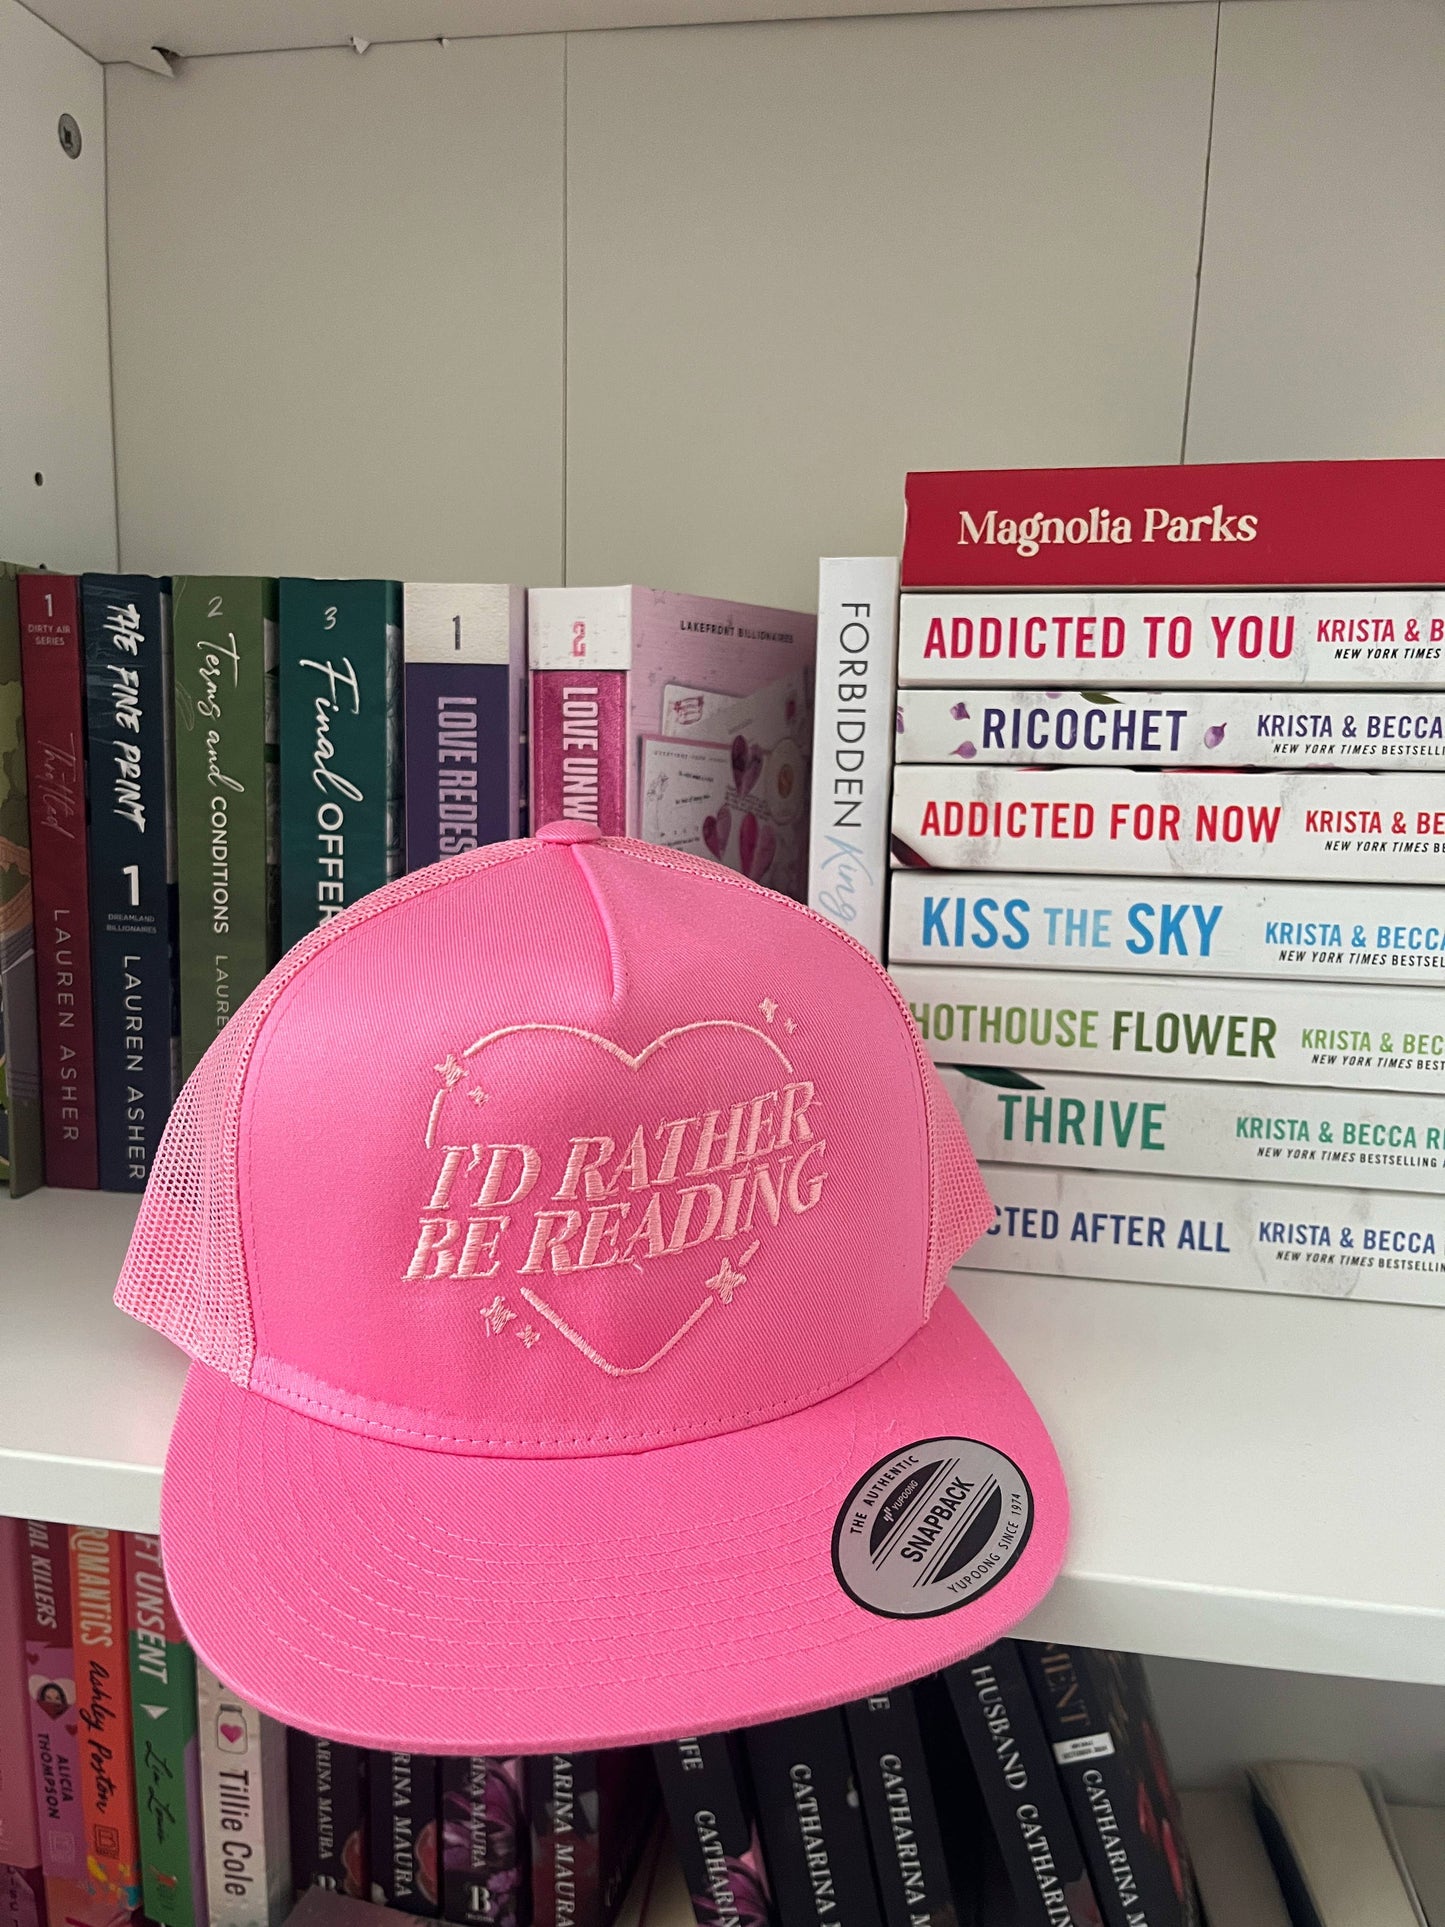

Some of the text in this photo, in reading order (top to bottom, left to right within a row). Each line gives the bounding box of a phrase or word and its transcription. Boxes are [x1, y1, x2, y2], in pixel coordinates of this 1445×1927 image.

[957, 504, 1259, 557] Magnolia Parks
[28, 625, 71, 634] DIRTY AIR
[45, 594, 53, 617] 1
[207, 595, 223, 618] 2
[323, 606, 338, 631] 3
[680, 620, 734, 636] LAKEFRONT
[1317, 619, 1395, 642] KRISTA
[1404, 618, 1420, 642] &
[35, 636, 65, 646] SERIES
[452, 615, 461, 650] 1
[572, 621, 586, 658] 2
[923, 615, 1296, 659] ADDICTED TO YOU
[1334, 648, 1441, 659] NEW YORK TIMES
[103, 603, 146, 833] THE FINE PRINT
[299, 656, 364, 801] Final
[982, 708, 1188, 751] RICOCHET
[1257, 714, 1443, 738] KRISTA & BECCA
[562, 687, 599, 825] LOVE UNW
[818, 602, 874, 925] FORBIDDEN King
[1273, 744, 1299, 754] NEW
[1305, 744, 1336, 754] YORK
[1340, 744, 1377, 755] TIMES
[438, 696, 478, 860] LOVE REDES
[197, 633, 244, 1032] Terms and CONDITIONS LAURE
[920, 801, 1282, 843] ADDICTED FOR NOW
[1305, 810, 1382, 833] KRISTA
[1391, 811, 1406, 834] &
[1324, 841, 1351, 851] NEW
[1356, 841, 1388, 852] YORK
[1392, 842, 1429, 852] TIMES
[122, 864, 140, 906] 1
[106, 924, 157, 934] BILLIONAIRES
[108, 913, 155, 923] DREAMLAND
[922, 896, 1223, 957] KISS THE SKY
[1265, 922, 1342, 947] KRISTA
[1351, 925, 1367, 948] &
[1279, 950, 1306, 962] NEW
[1312, 951, 1344, 964] YORK
[1349, 953, 1387, 965] TIMES
[54, 909, 79, 1141] LAUREN ASHER
[909, 1002, 1278, 1058] HOTHOUSE FLOWER
[1301, 1028, 1371, 1052] KRISTA
[1379, 1032, 1393, 1053] &
[124, 956, 146, 1180] LAUREN ASHER
[1311, 1054, 1337, 1065] NEW
[1342, 1056, 1371, 1067] YORK
[1377, 1057, 1412, 1069] TIMES
[424, 1081, 823, 1210] I'D RATHER
[998, 1094, 1167, 1151] THRIVE
[1236, 1117, 1310, 1142] KRISTA
[1318, 1121, 1333, 1143] &
[1342, 1123, 1417, 1148] BECCA
[1257, 1147, 1282, 1158] NEW
[1286, 1149, 1316, 1160] YORK
[1320, 1150, 1356, 1163] TIMES
[1360, 1153, 1437, 1168] BESTSELLING
[401, 1139, 829, 1281] BE READING
[1070, 1211, 1166, 1249] AFTER
[1178, 1219, 1231, 1253] ALL
[1259, 1221, 1435, 1254] KRISTA & BECCA
[1276, 1250, 1301, 1261] NEW
[1306, 1252, 1335, 1264] YORK
[1339, 1255, 1374, 1267] TIMES
[850, 1455, 919, 1534] THE AUTHENTIC
[892, 1480, 919, 1510] YUPOONG
[900, 1476, 975, 1562] SNAPBACK
[947, 1493, 1022, 1593] YUPOONG SINCE 1974
[31, 1554, 57, 1629] KILLERS
[135, 1571, 168, 1684] UNSENT
[79, 1660, 110, 1732] Ashley
[970, 1664, 1028, 1790] HUSBAND
[37, 1733, 61, 1820] THOMPSON
[55, 1755, 73, 1802] ALICIA
[94, 1745, 119, 1814] Poston
[219, 1770, 254, 1896] Tillie Cole
[318, 1797, 334, 1860] MAURA
[472, 1802, 487, 1868] MAURA
[789, 1764, 836, 1915] CATHARINA
[879, 1754, 926, 1905] CATHARINA
[1081, 1768, 1138, 1907] CATHARINA
[393, 1815, 413, 1897] MAURA
[555, 1843, 575, 1927] MAURA
